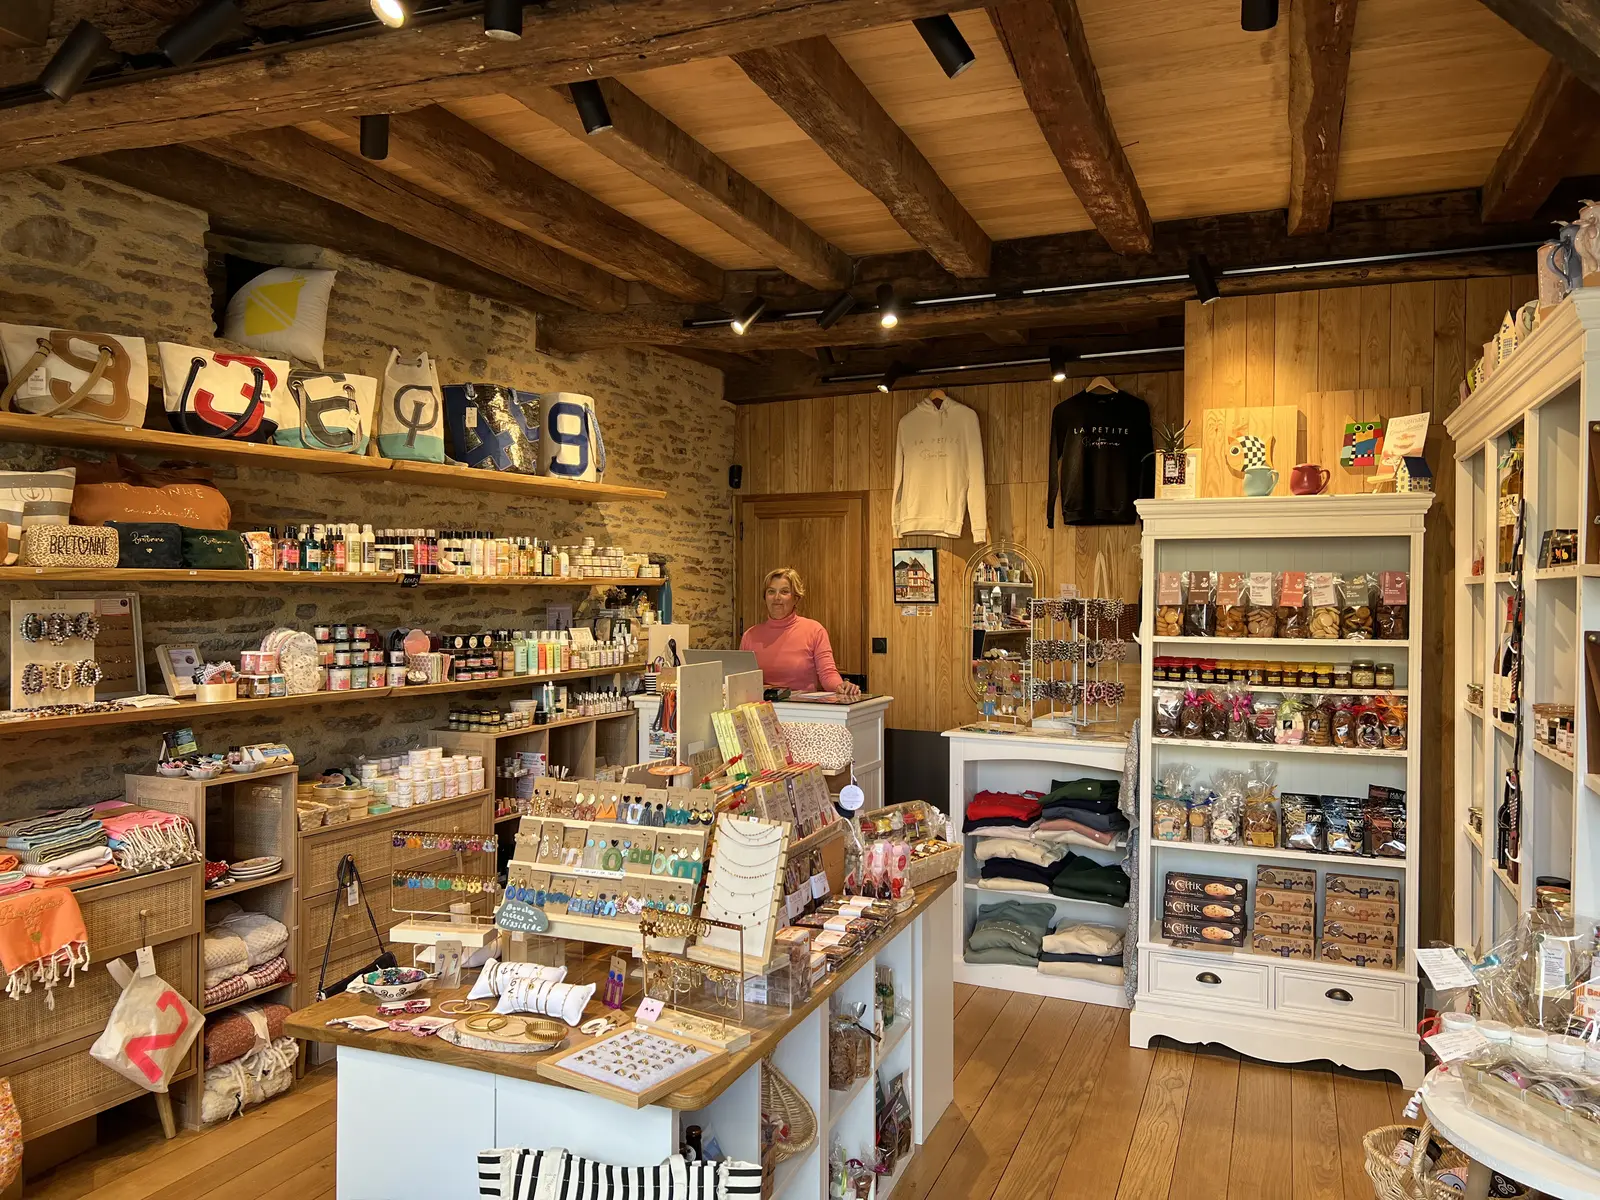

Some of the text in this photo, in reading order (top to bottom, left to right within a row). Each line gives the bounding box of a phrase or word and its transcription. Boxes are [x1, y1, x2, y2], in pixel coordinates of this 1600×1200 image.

[548, 402, 588, 476] 9
[1073, 426, 1129, 435] LA PETITE
